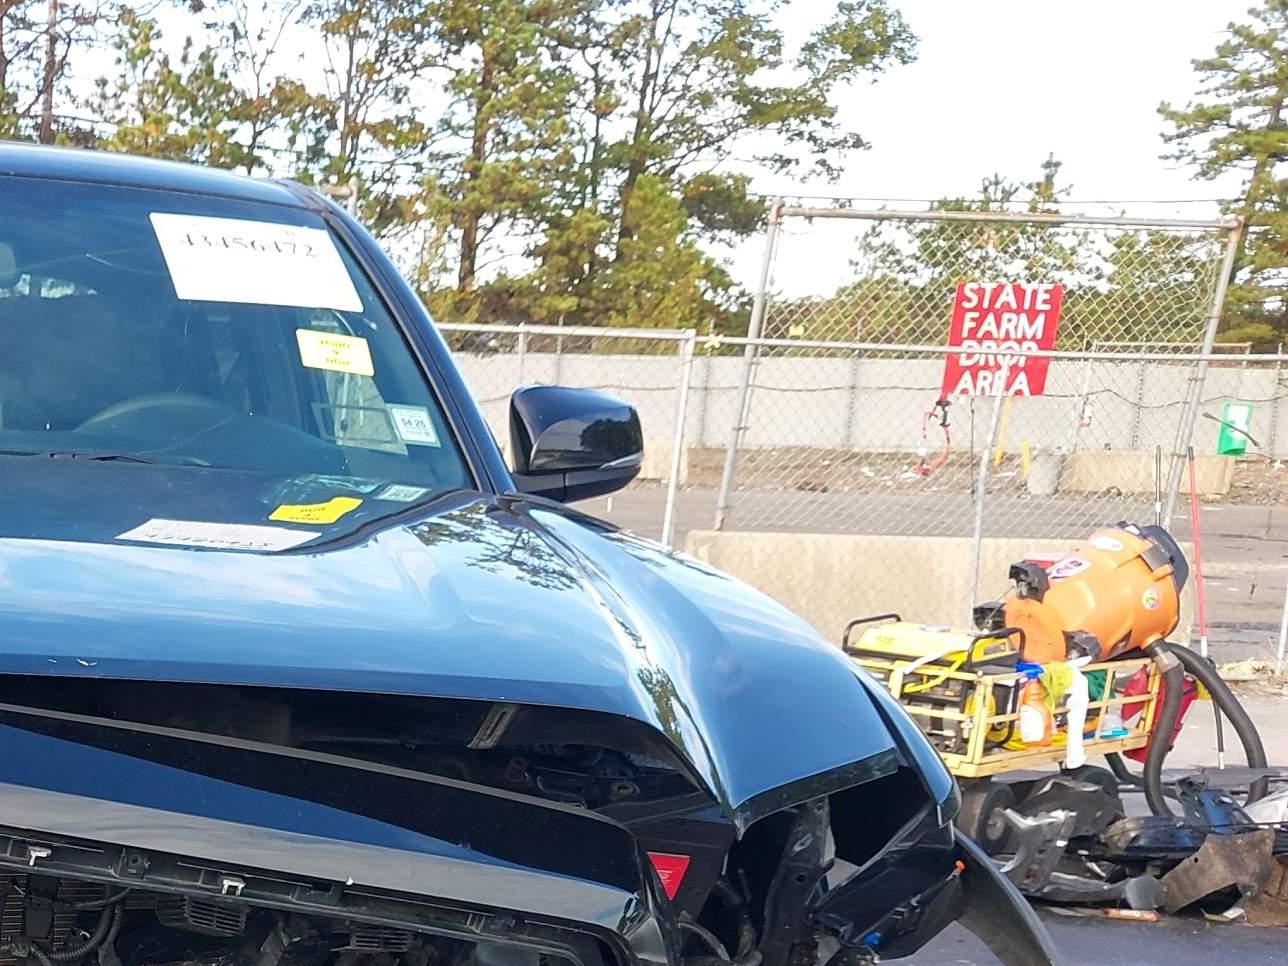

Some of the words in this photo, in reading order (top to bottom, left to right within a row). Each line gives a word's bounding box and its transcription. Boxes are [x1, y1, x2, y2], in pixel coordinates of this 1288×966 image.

[960, 281, 1055, 311] STATE
[960, 311, 1046, 340] FARM
[958, 339, 1039, 368] DROP
